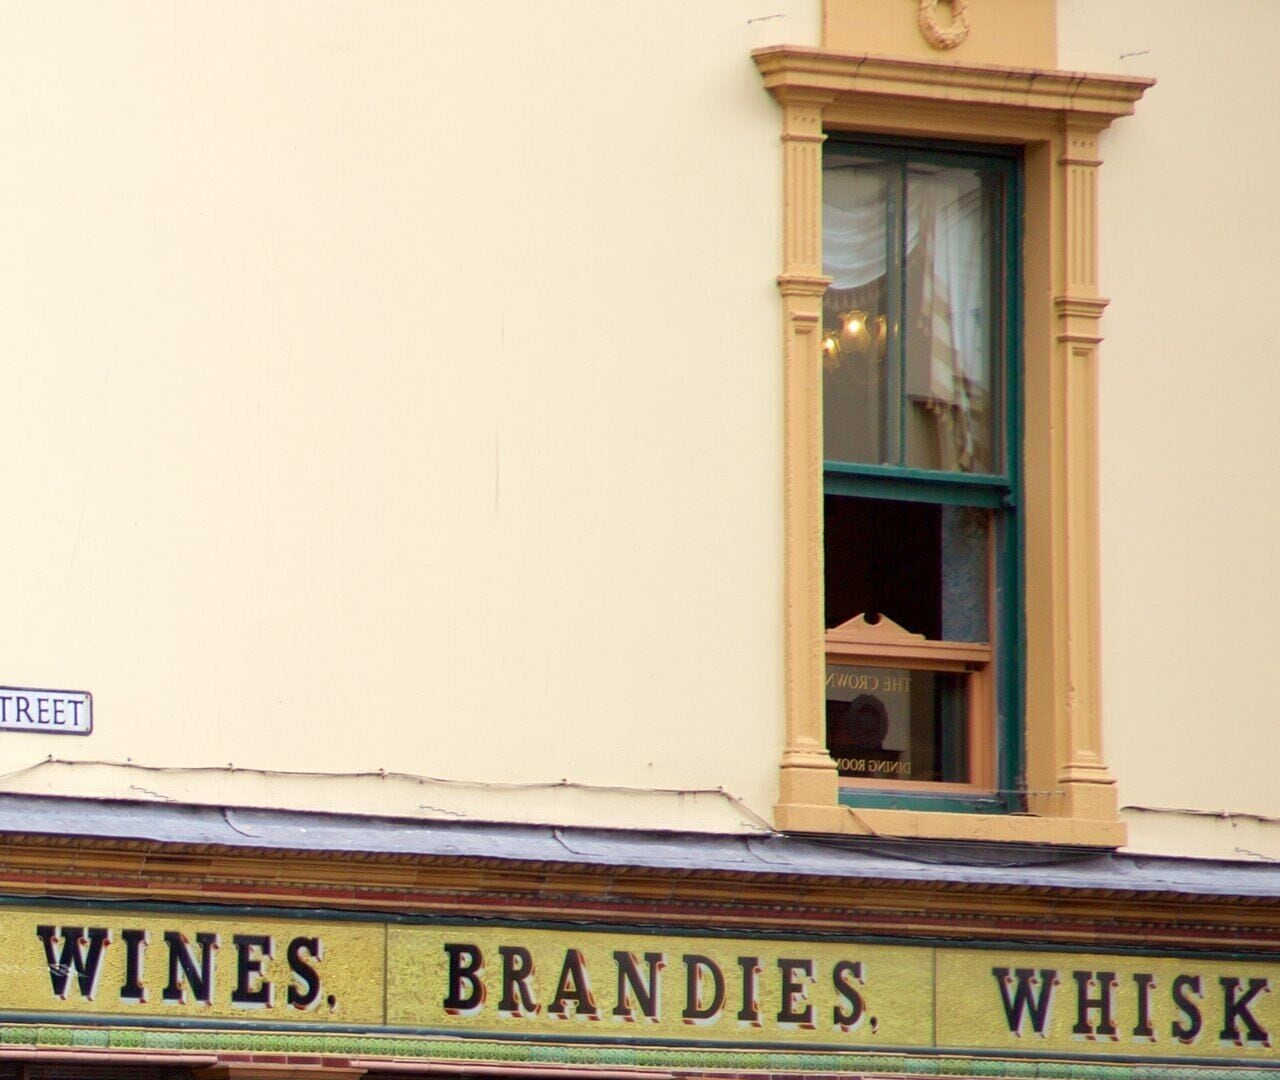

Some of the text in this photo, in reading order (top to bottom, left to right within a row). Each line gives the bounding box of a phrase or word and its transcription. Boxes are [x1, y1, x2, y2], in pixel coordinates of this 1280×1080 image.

[36, 925, 1272, 1047] WINES, BRANDIES, WHISK
